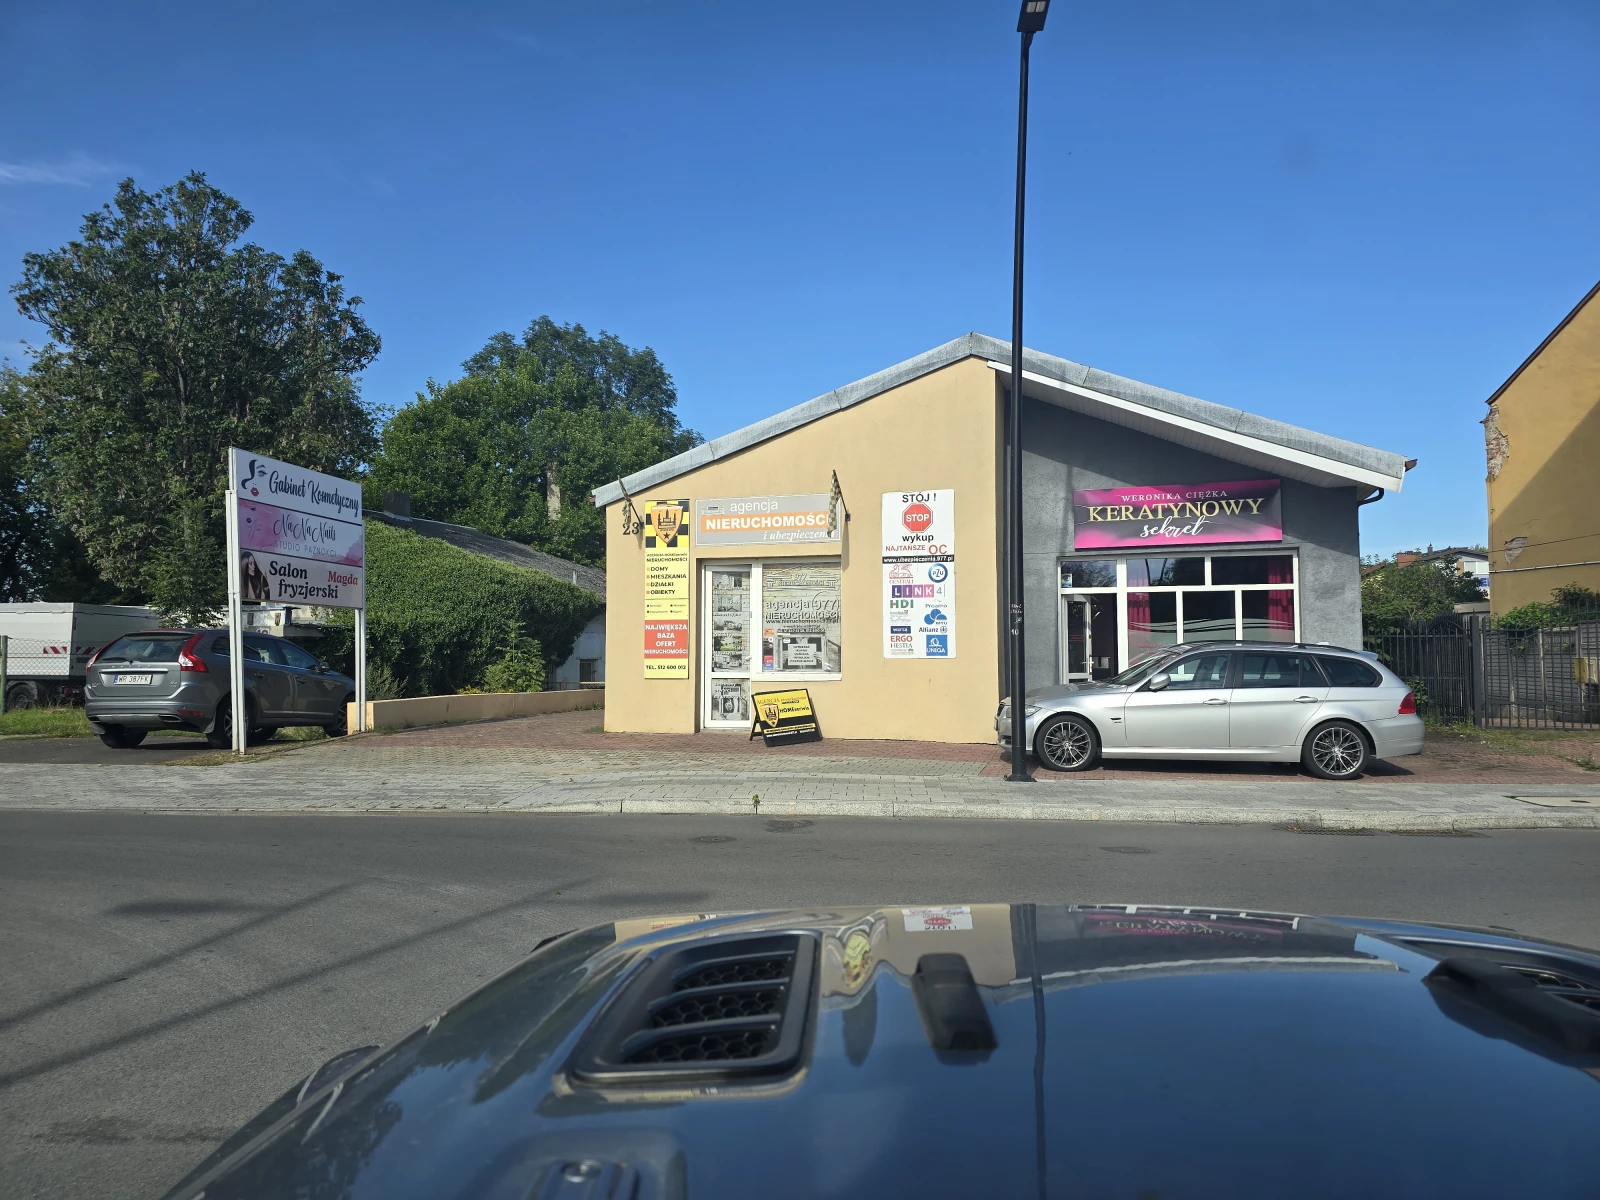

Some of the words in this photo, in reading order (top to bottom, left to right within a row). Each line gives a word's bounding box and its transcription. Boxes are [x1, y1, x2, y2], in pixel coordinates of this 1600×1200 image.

[269, 470, 306, 498] Gabinet
[308, 480, 359, 517] Kosmetyczny
[902, 492, 930, 503] STÓJ
[1122, 493, 1181, 502] WERONIKA
[1186, 490, 1227, 500] CIĘŻKA
[730, 500, 779, 514] agencja
[1088, 498, 1264, 523] KERATYNOWY
[905, 513, 930, 522] STOP
[623, 522, 640, 535] 23
[1140, 515, 1210, 538] sekret
[902, 533, 934, 544] wykup
[274, 540, 300, 552] STUDIO
[304, 545, 337, 557] PAZNOKCI
[885, 544, 926, 552] NAJTAŃSZE
[928, 544, 948, 555] OC
[269, 561, 308, 580] Salon
[932, 568, 944, 578] PZU
[327, 570, 358, 587] Magda
[278, 579, 339, 600] fryzjerski
[766, 599, 810, 611] agencja
[890, 599, 914, 609] HDI
[1010, 628, 1020, 636] 10
[890, 635, 913, 643] ERGO
[118, 675, 128, 683] WR
